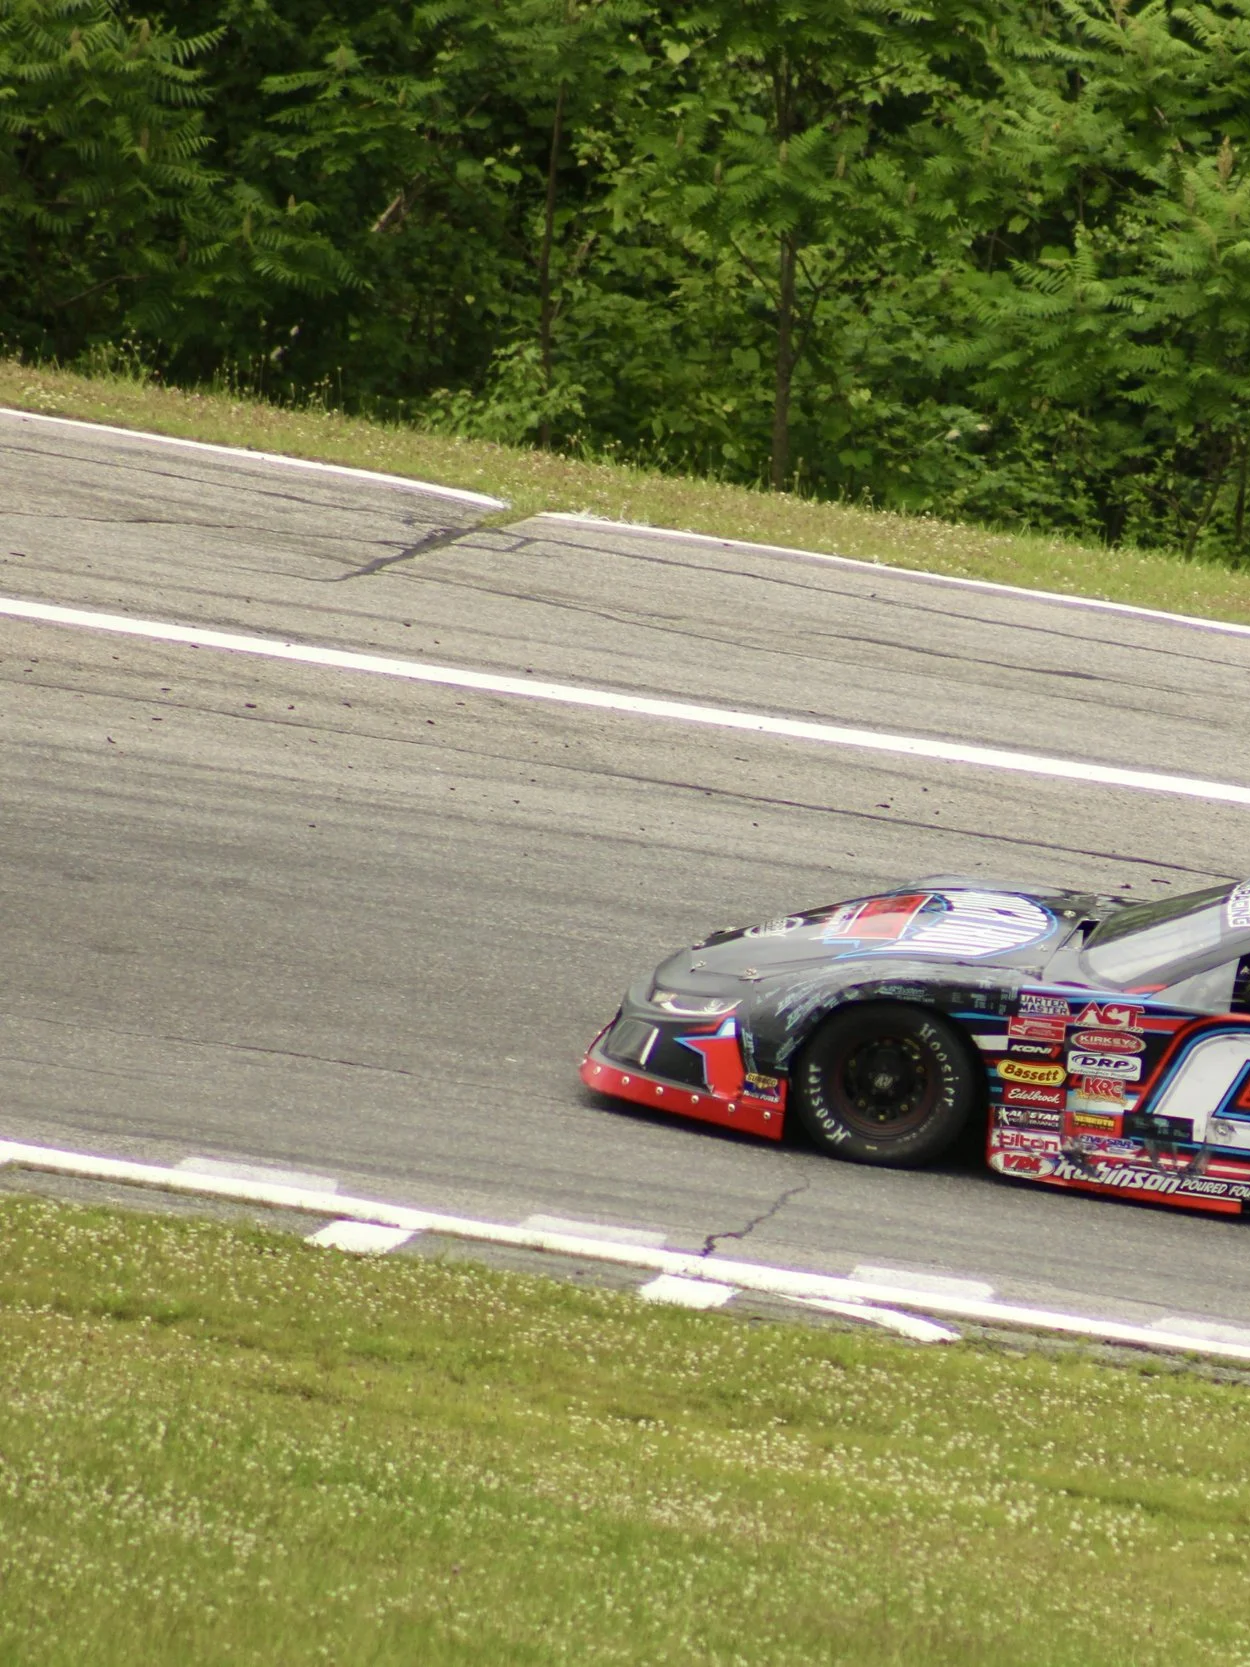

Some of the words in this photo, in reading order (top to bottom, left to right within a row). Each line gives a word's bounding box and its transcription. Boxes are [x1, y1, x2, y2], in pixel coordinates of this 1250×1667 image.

[1020, 1003, 1068, 1016] MASTER
[1074, 1000, 1145, 1028] ACT
[1079, 1034, 1131, 1046] KIRKEY
[1010, 1044, 1052, 1055] KONI
[918, 1023, 960, 1107] Hoosier
[1081, 1056, 1129, 1069] DRP
[1004, 1063, 1059, 1081] Bassett
[1008, 1087, 1060, 1104] Edelbrock
[1084, 1076, 1124, 1098] KRC
[804, 1063, 852, 1145] Hoosier
[997, 1131, 1059, 1151] tilton
[1180, 1178, 1228, 1195] POURED
